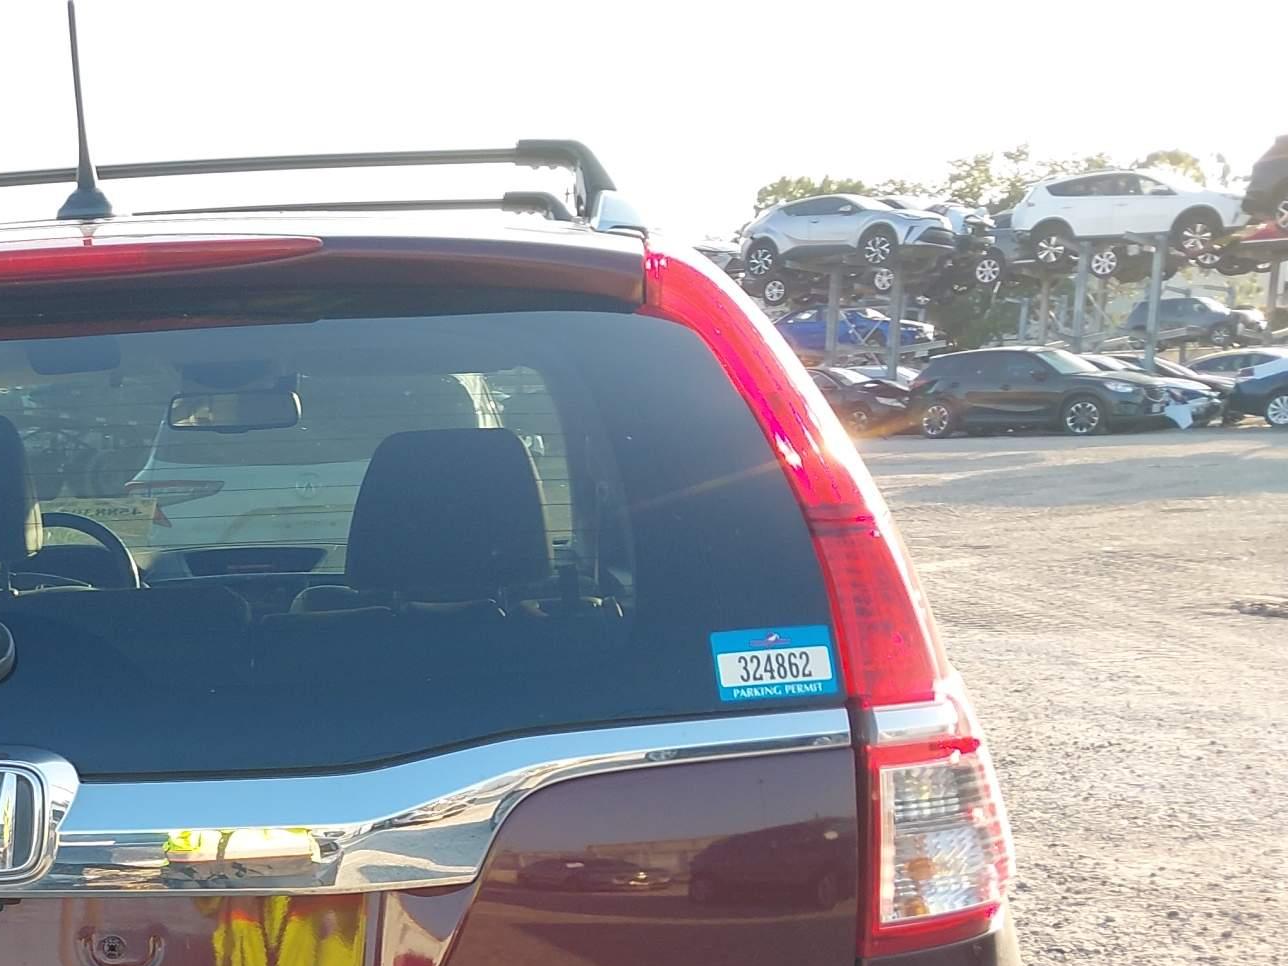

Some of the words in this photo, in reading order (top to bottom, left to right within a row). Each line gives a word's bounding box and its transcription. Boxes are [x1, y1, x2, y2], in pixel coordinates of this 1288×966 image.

[737, 651, 812, 682] 324862
[733, 684, 782, 698] PARKING
[784, 682, 823, 695] PERMIT
